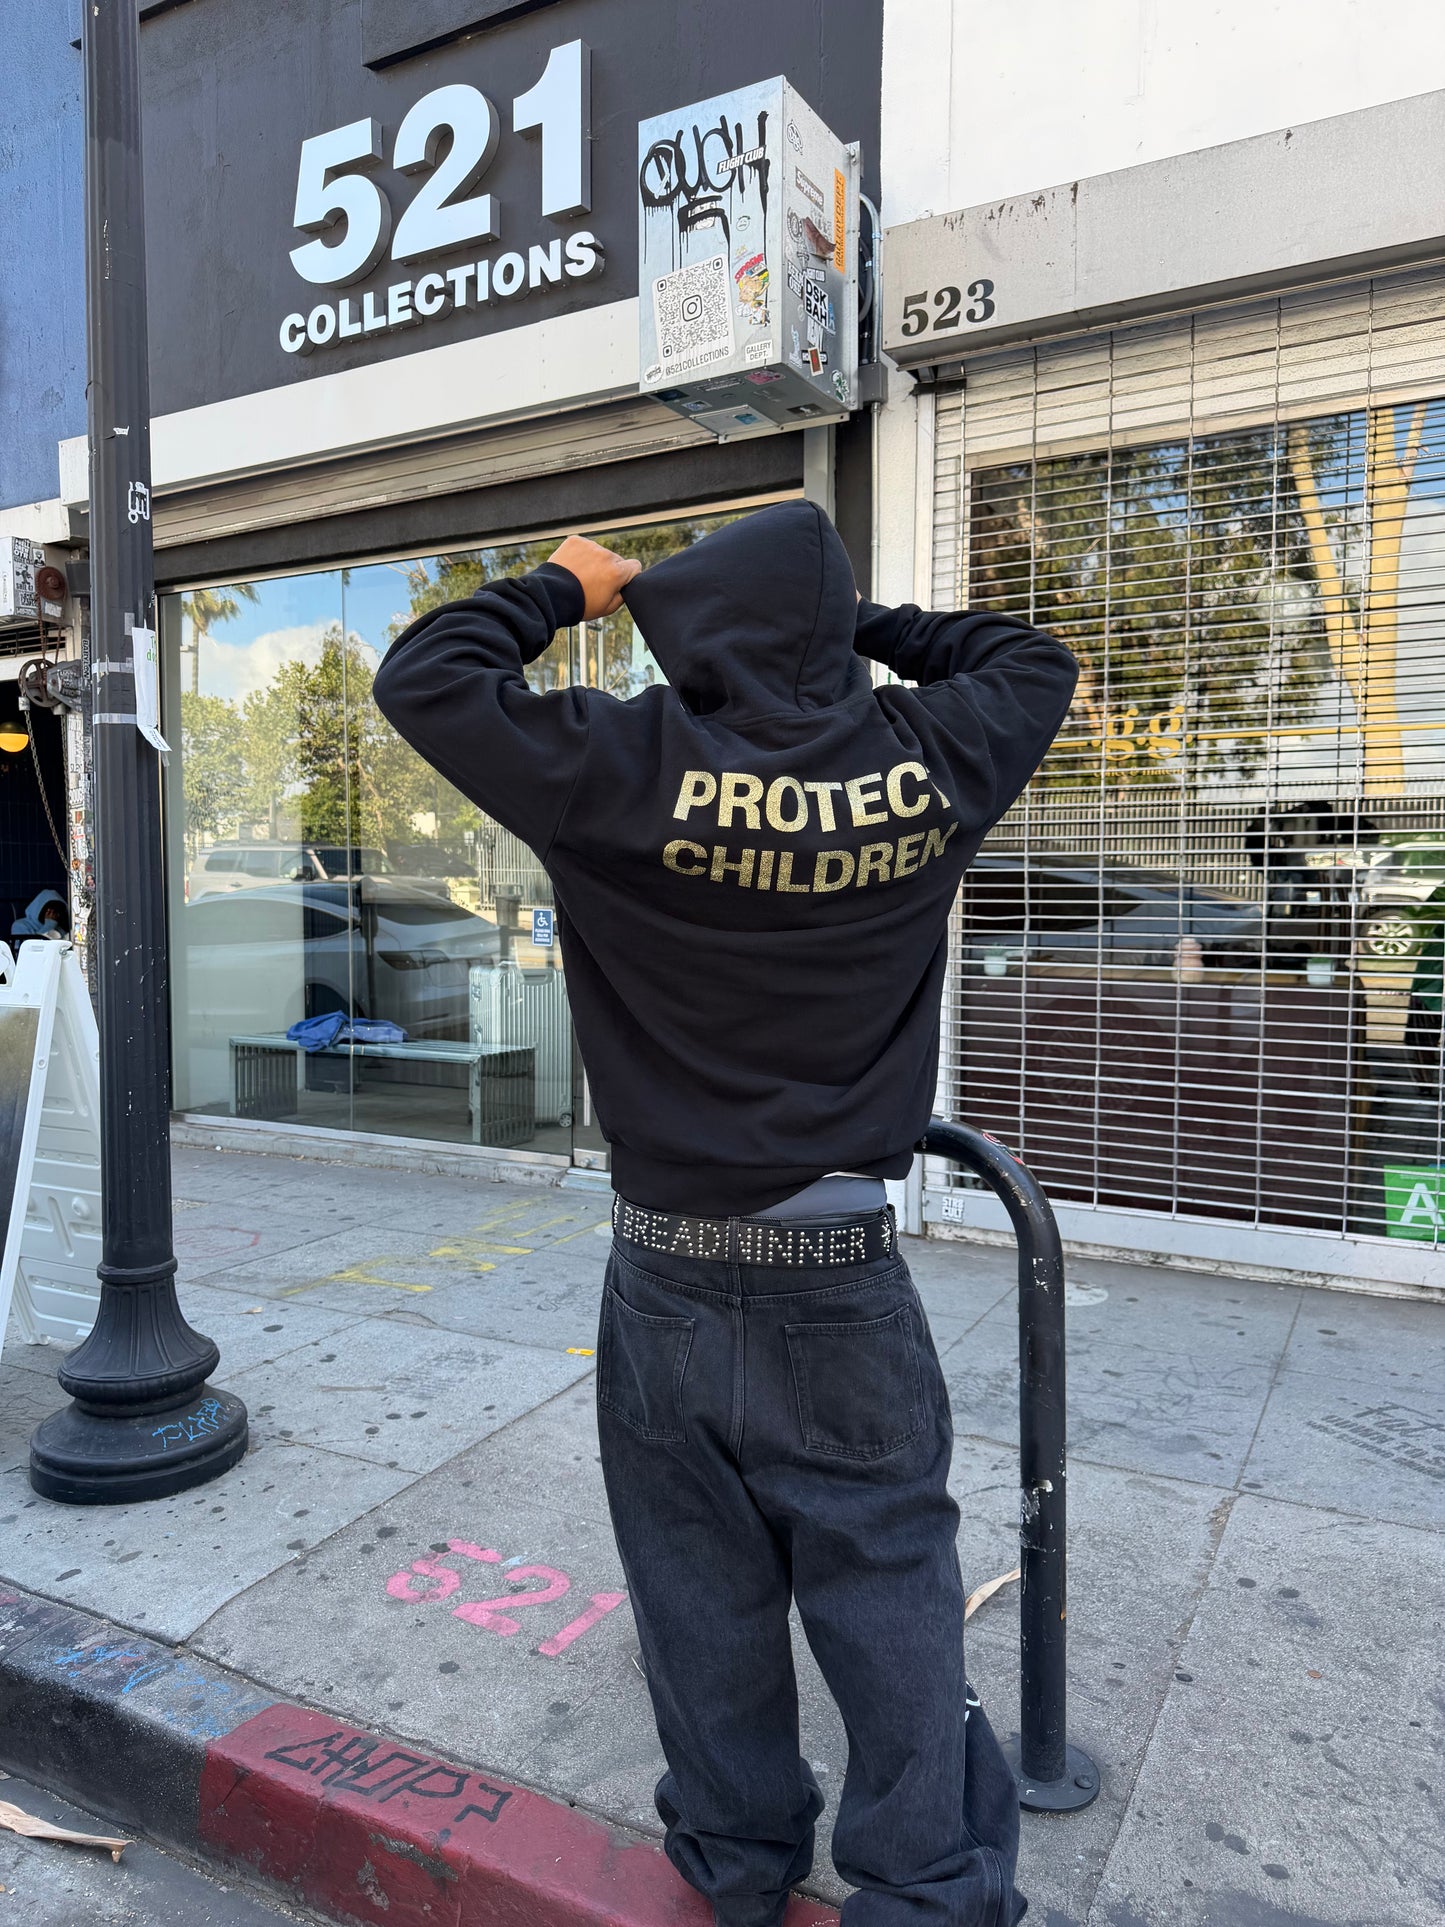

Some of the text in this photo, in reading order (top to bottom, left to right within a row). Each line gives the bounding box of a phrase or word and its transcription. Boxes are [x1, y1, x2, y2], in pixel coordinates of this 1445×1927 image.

[289, 38, 590, 286] 521
[718, 147, 764, 173] FLIGHT CLUB
[279, 231, 604, 353] COLLECTIONS
[806, 280, 828, 310] DSK
[900, 279, 995, 336] 523
[806, 297, 828, 328] BAH
[665, 346, 729, 376] @521COLLECTIONS
[746, 341, 771, 354] GALLERY
[749, 351, 768, 361] DEPT.
[662, 822, 958, 893] CHILDREN
[1400, 1183, 1445, 1225] A
[386, 1538, 628, 1657] 521
